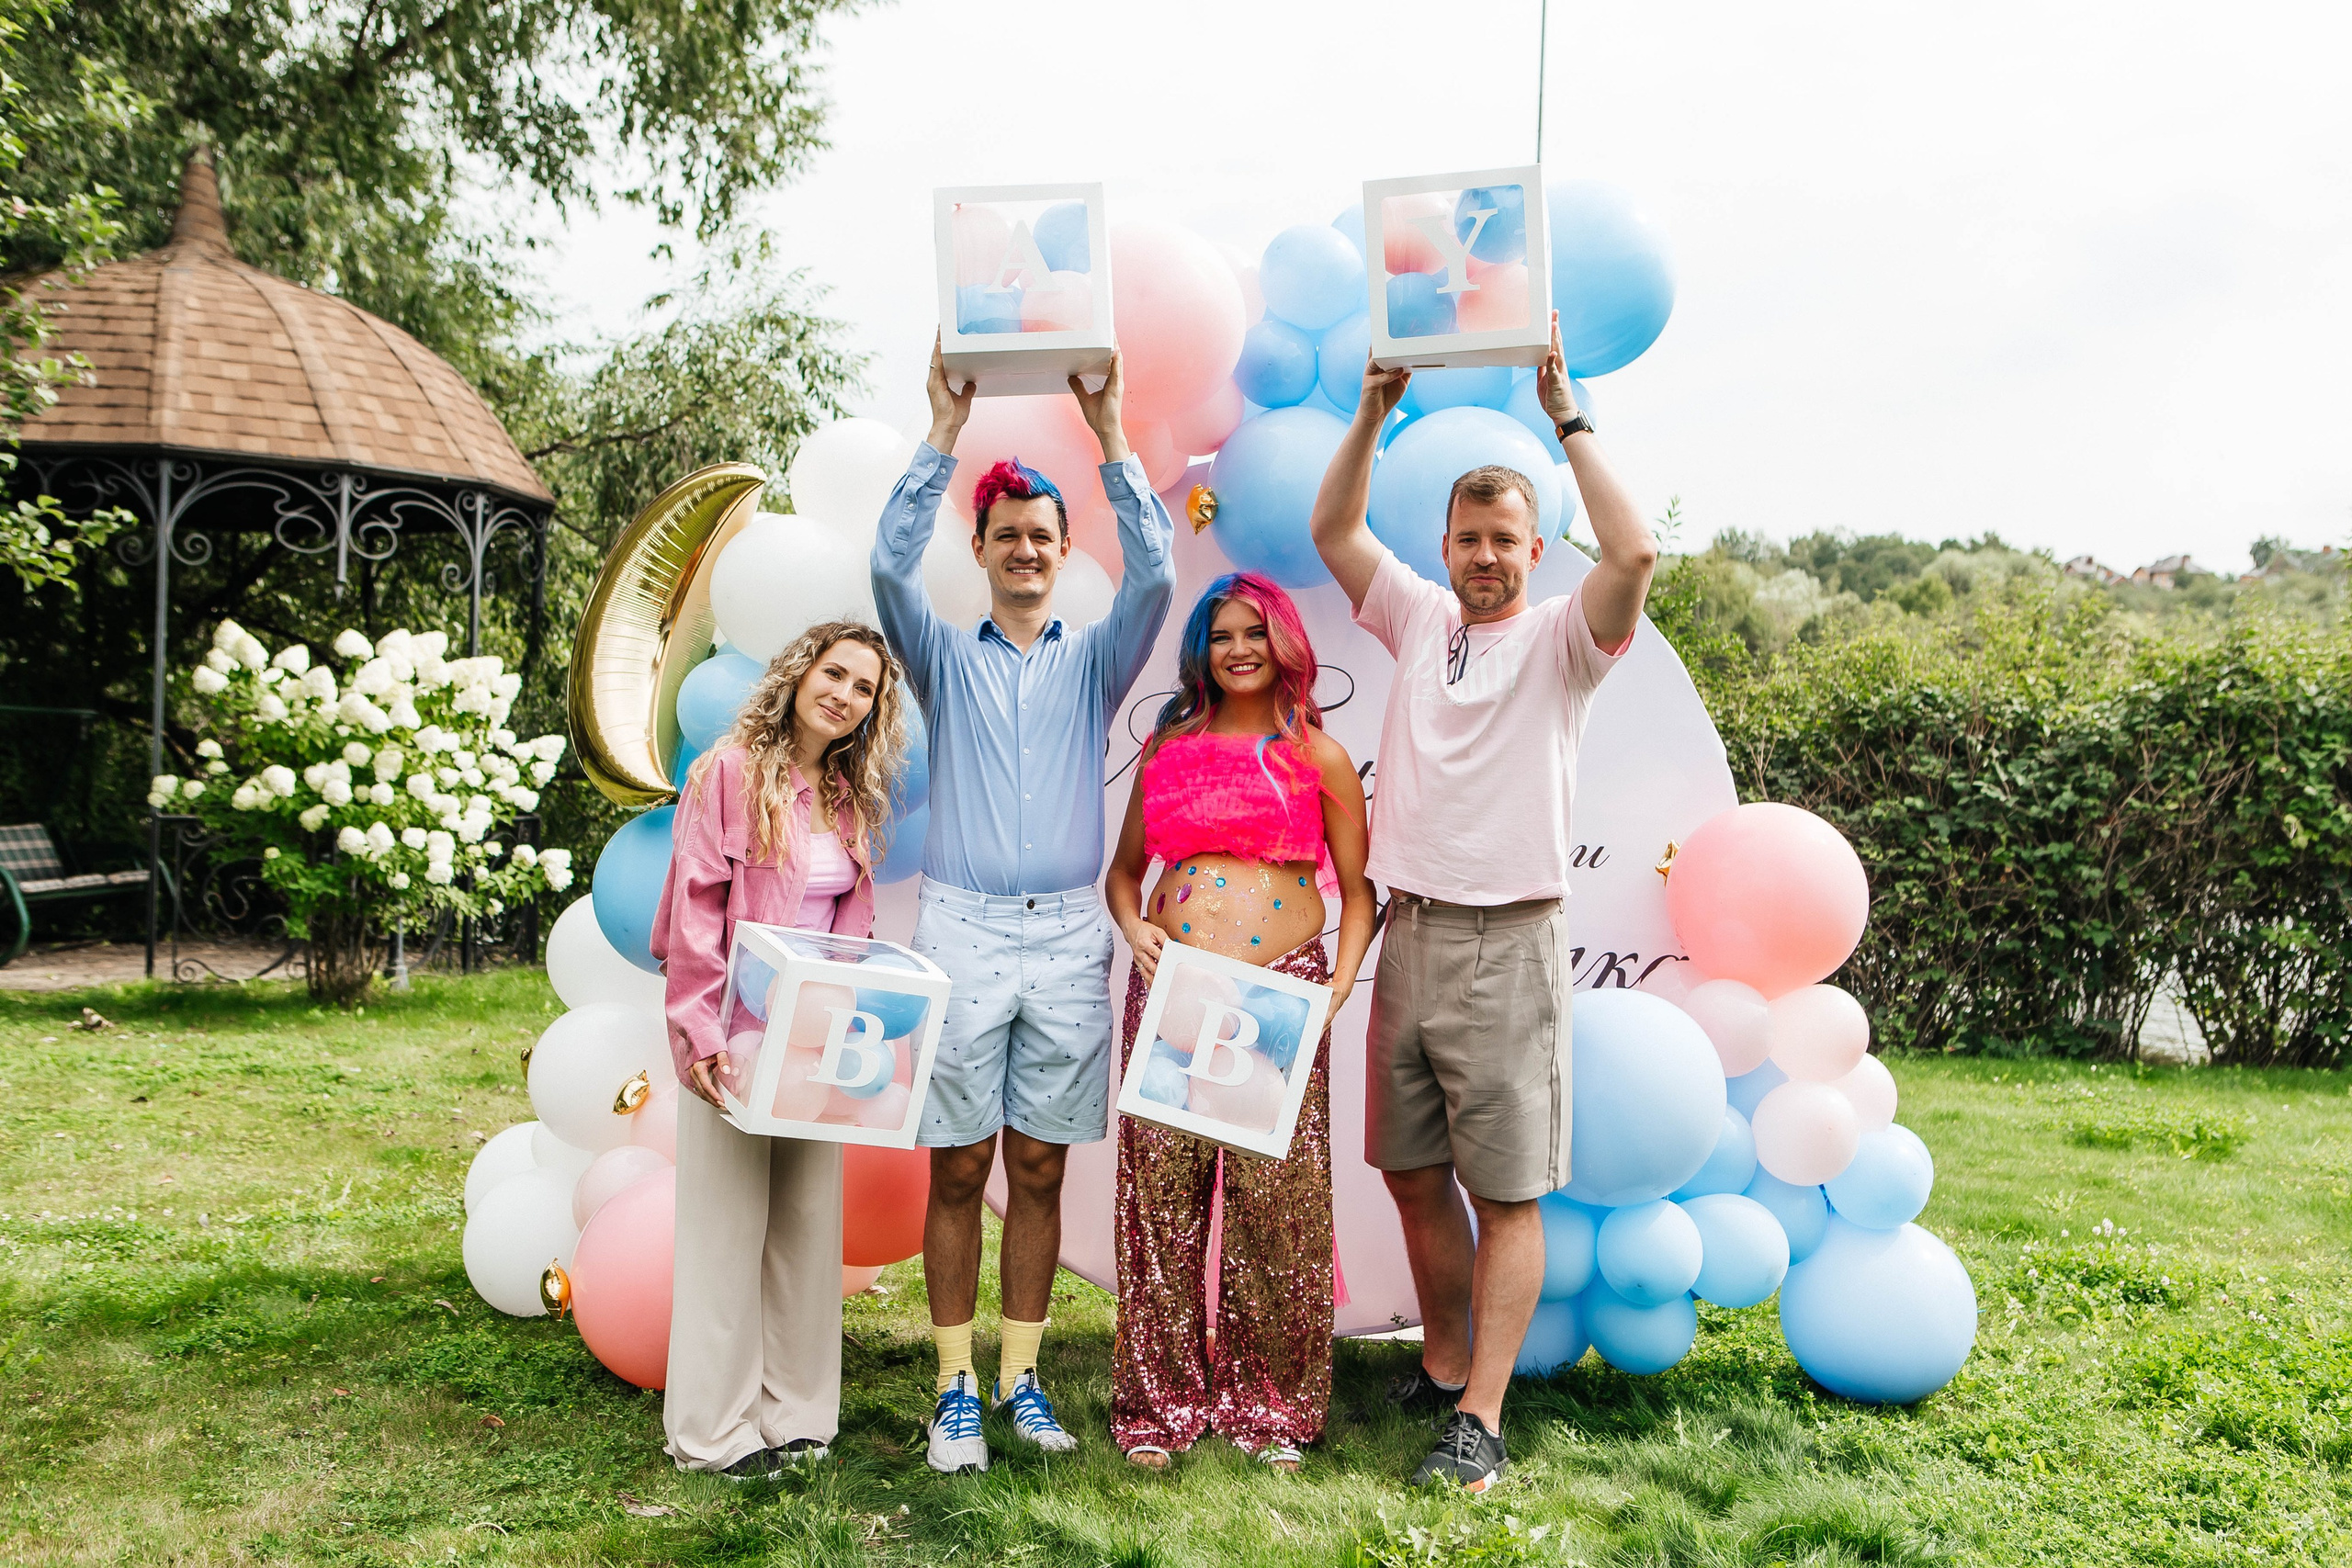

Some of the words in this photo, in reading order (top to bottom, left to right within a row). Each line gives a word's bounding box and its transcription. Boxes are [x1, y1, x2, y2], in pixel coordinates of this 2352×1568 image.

[984, 220, 1065, 293] A
[1407, 209, 1498, 294] Y
[806, 1006, 886, 1088] B
[1177, 998, 1261, 1087] B
